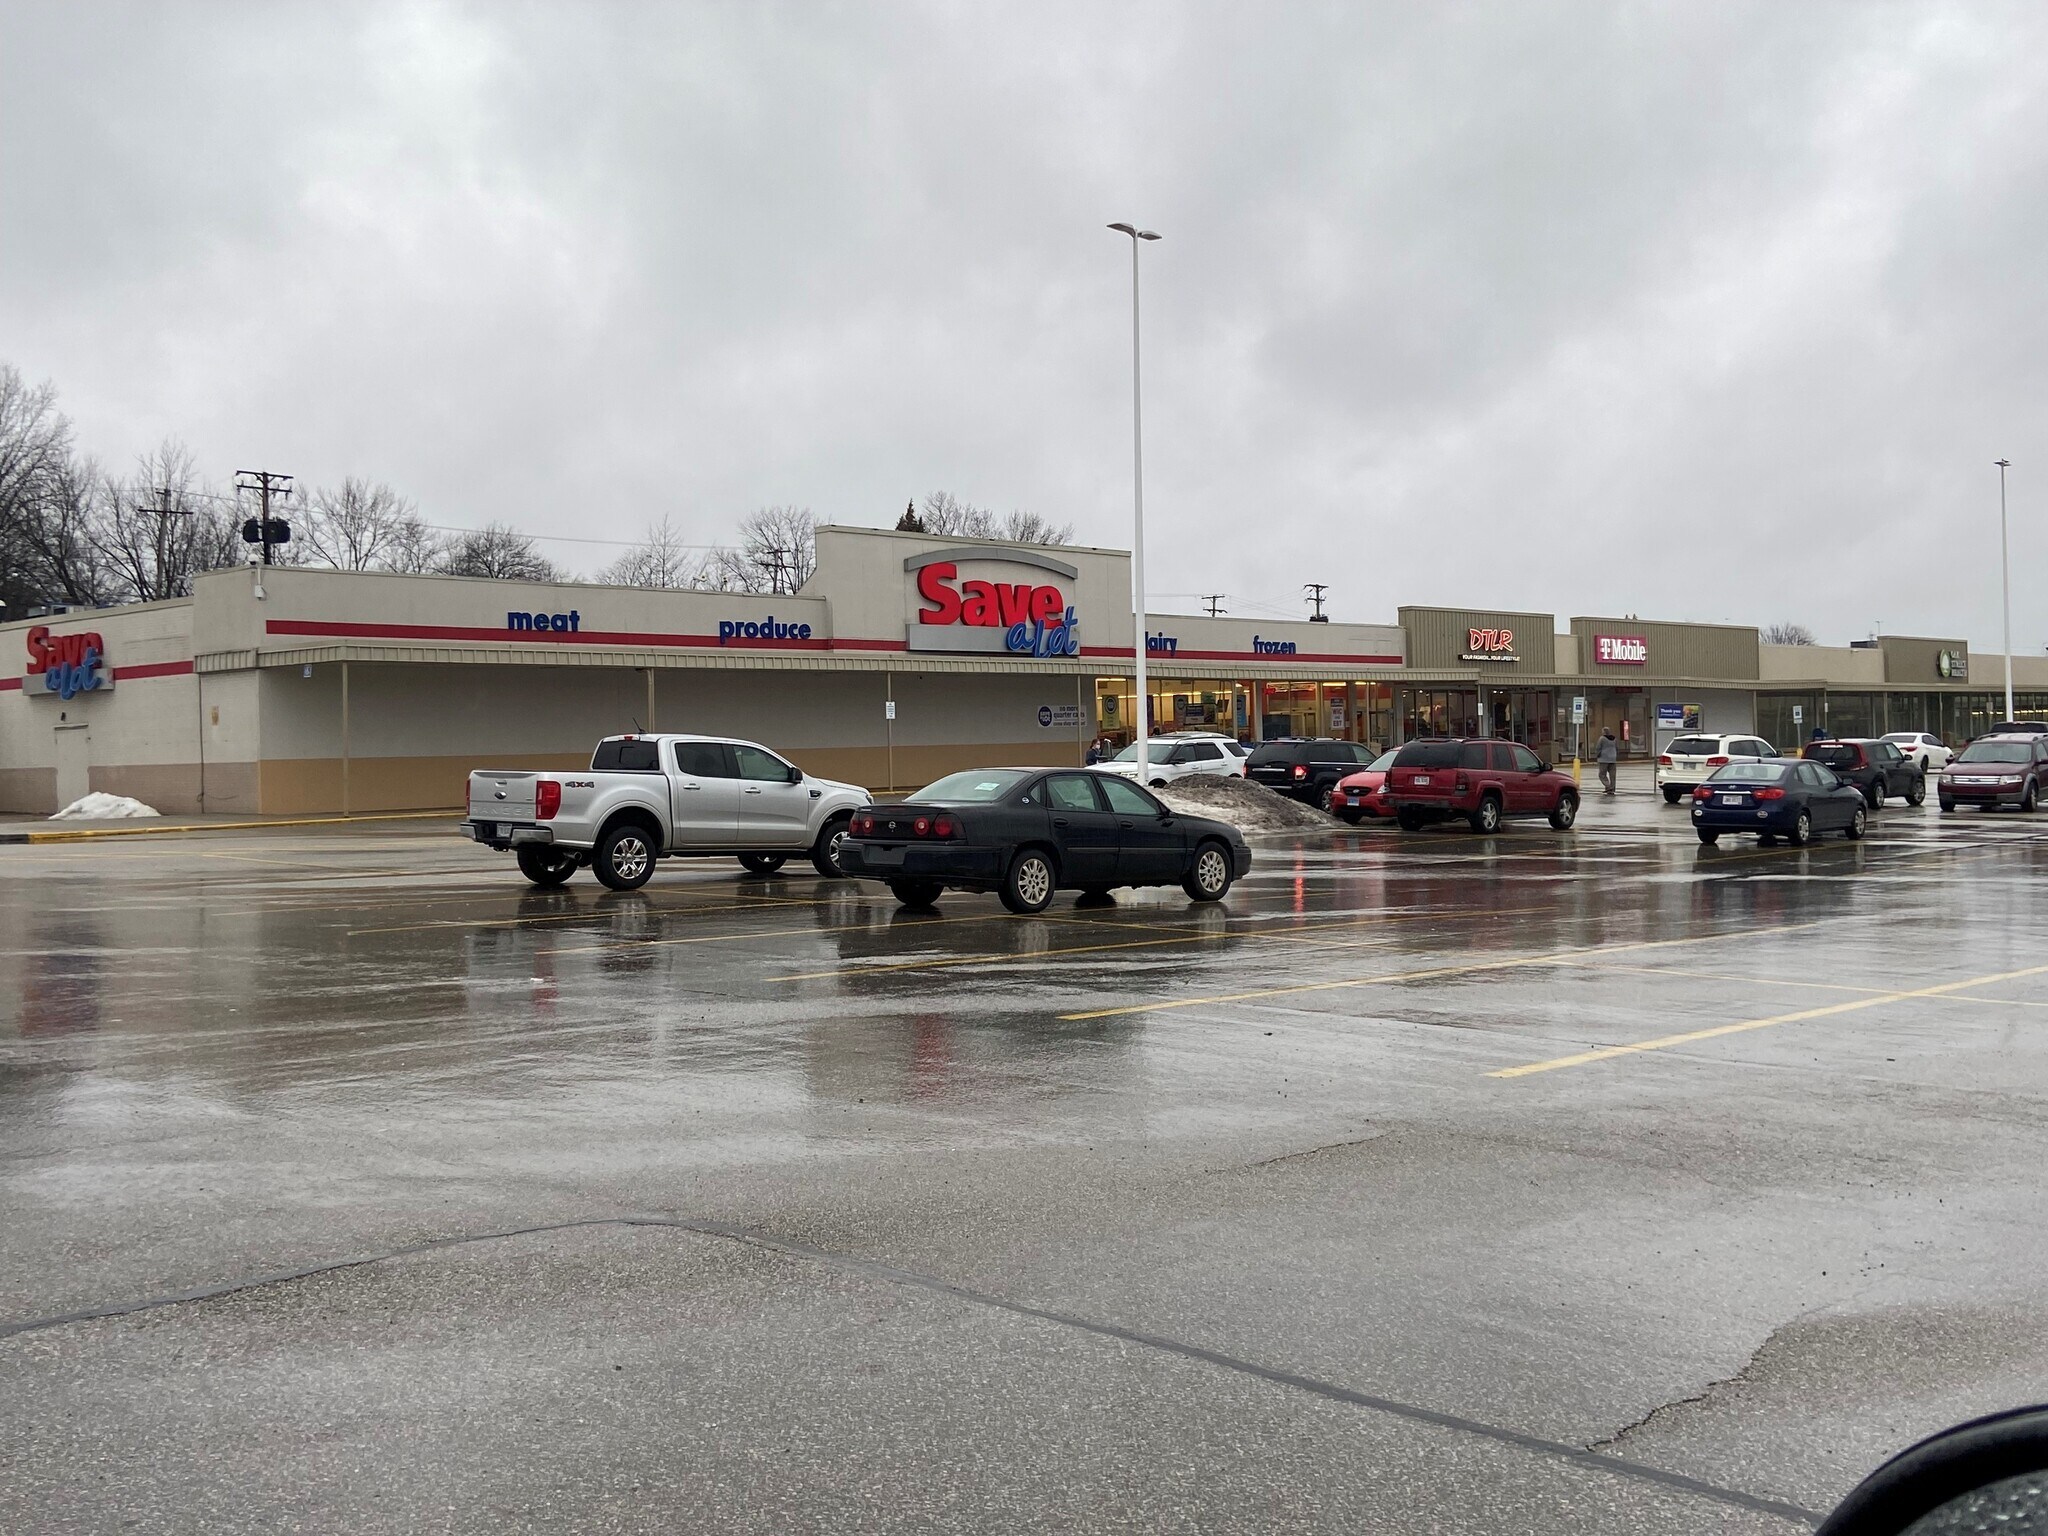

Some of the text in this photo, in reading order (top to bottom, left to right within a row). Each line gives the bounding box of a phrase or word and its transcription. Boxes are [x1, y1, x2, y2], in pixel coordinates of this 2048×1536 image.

[917, 562, 1063, 629] Save
[507, 610, 580, 632] meat
[719, 616, 811, 644] produce
[27, 627, 104, 675] Save
[1253, 635, 1297, 655] frozen
[1469, 628, 1513, 652] DTLR
